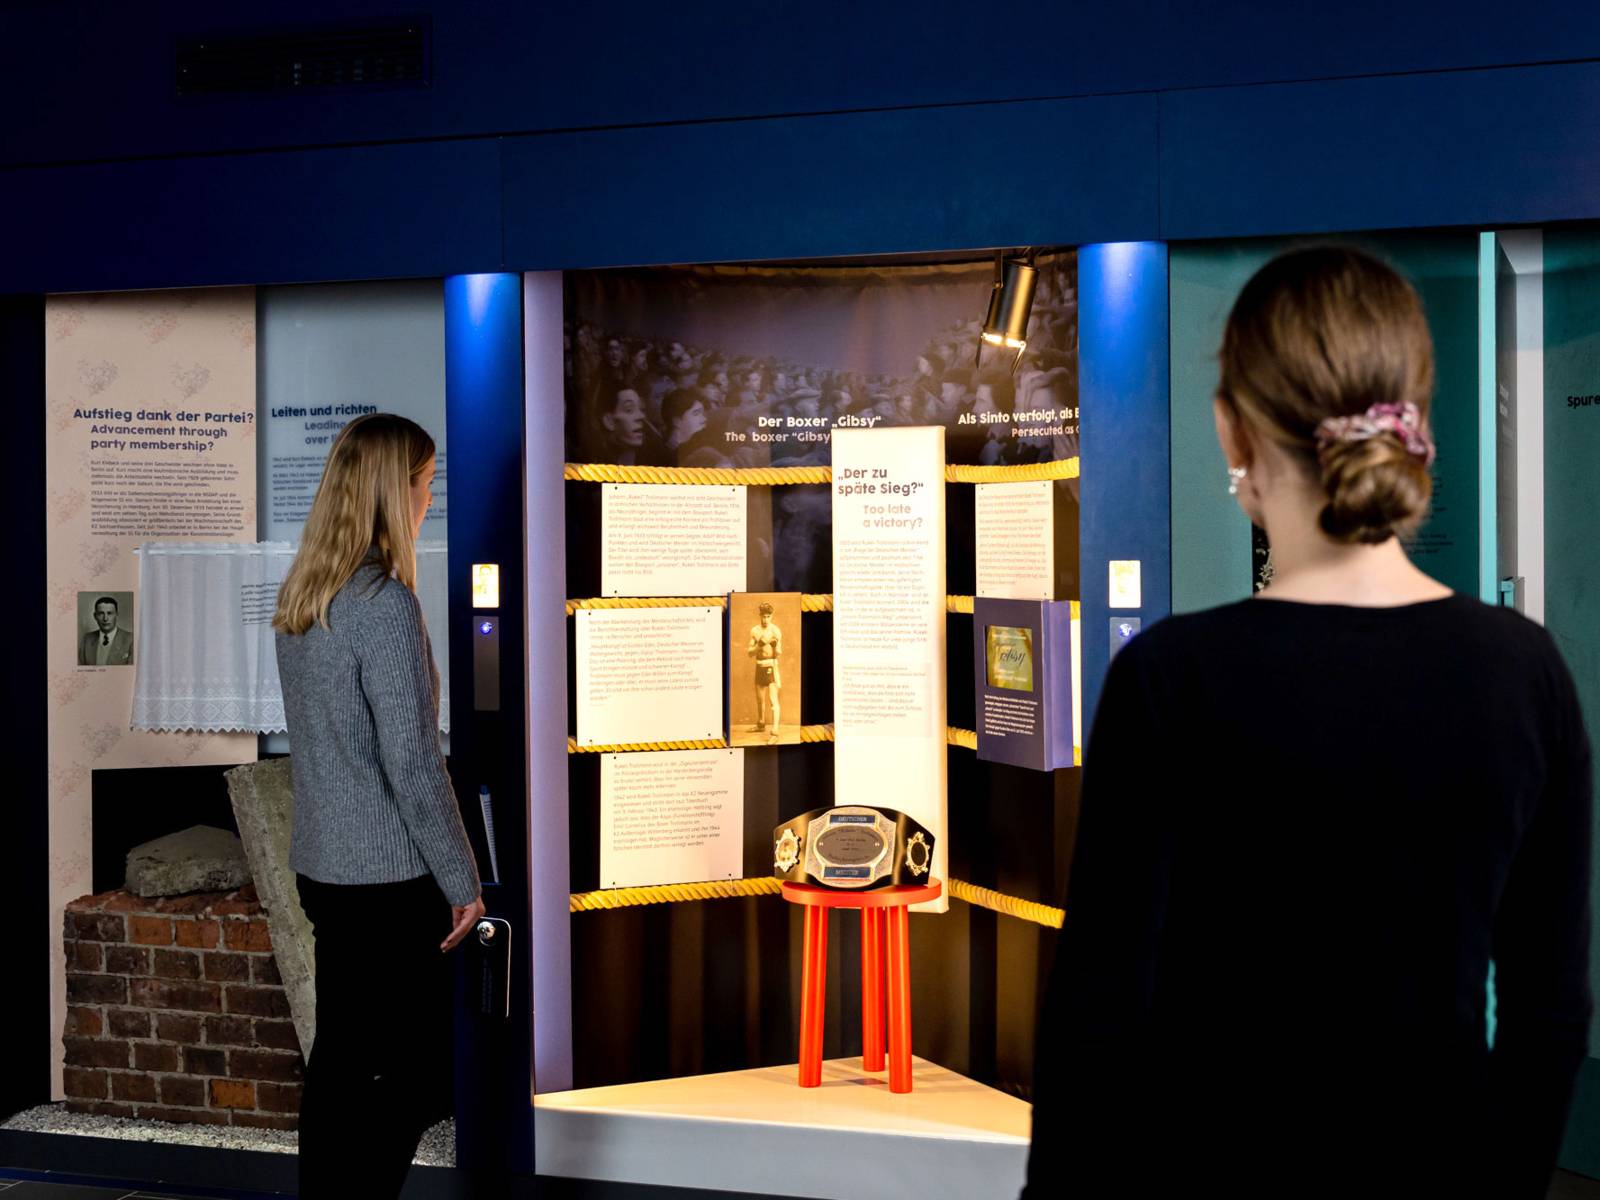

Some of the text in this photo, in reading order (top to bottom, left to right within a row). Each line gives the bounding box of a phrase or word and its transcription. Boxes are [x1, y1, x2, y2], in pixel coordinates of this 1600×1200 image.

[73, 408, 254, 424] Aufstieg dank der Partei?
[272, 403, 377, 418] Leiten und richten
[958, 412, 977, 424] Als
[980, 411, 1010, 424] Sinto
[1012, 408, 1058, 424] verfolgt,
[1060, 408, 1073, 420] als
[758, 414, 882, 428] Der Boxer „Gibsy“
[90, 424, 228, 440] Advancement through
[725, 432, 746, 442] The
[752, 432, 789, 442] boxer
[1012, 424, 1063, 438] Persecuted
[1064, 426, 1074, 435] as
[90, 439, 214, 452] party membership?
[305, 434, 328, 444] over
[838, 468, 888, 480] „Der zu
[838, 482, 924, 496] späte Sieg?“
[864, 504, 912, 514] Too late
[863, 518, 923, 530] a victory?
